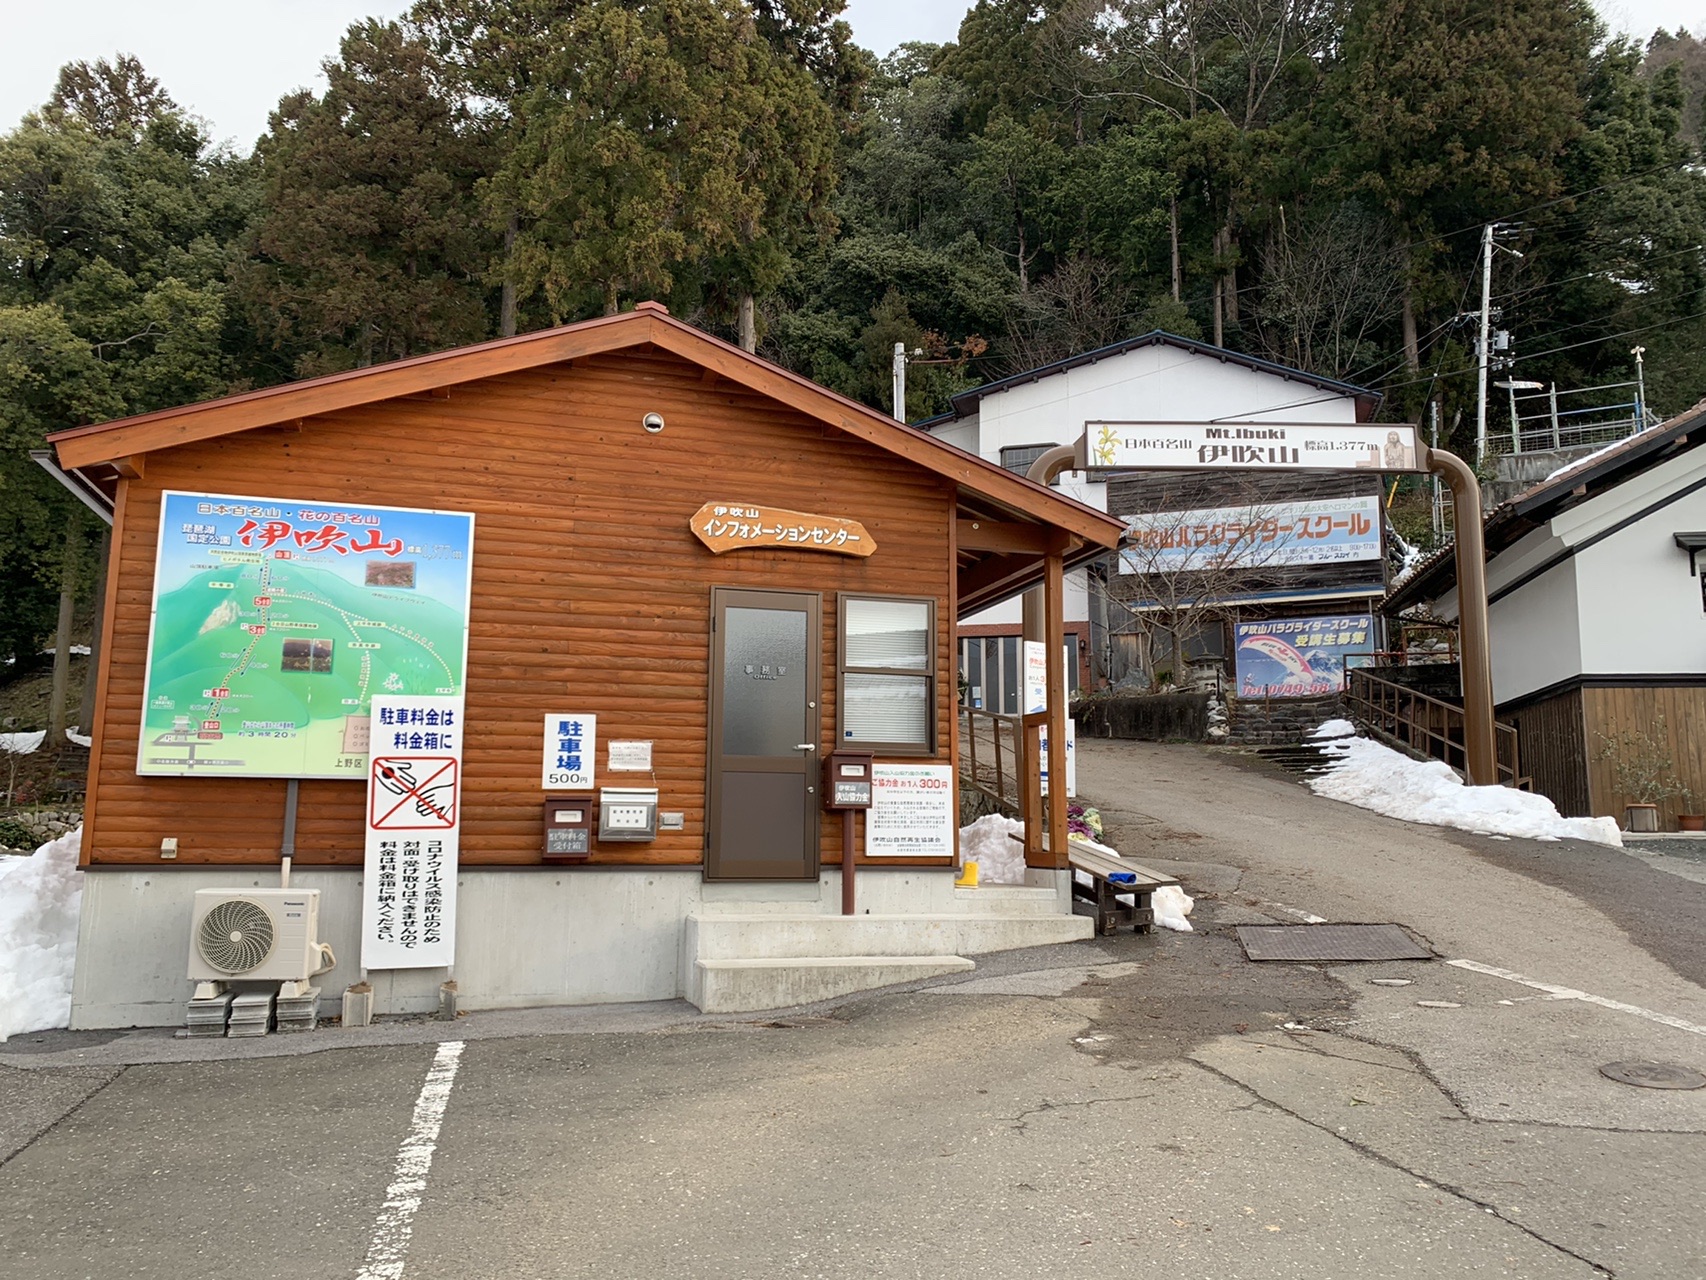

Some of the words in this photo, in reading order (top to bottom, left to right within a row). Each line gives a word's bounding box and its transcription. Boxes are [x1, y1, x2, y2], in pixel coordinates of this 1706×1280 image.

[1206, 428, 1286, 440] Mt.Ibuki
[1125, 438, 1193, 450] 日本百名山
[1304, 440, 1379, 452] 標高1,377m
[1197, 443, 1300, 464] 伊吹山
[713, 506, 759, 519] 伊吹山
[236, 519, 404, 558] 伊吹山
[702, 518, 861, 546] インフォメーションセンター
[1239, 619, 1369, 636] 伊吹山パラグライダースクール
[1295, 632, 1367, 648] 受講生募集
[744, 665, 787, 676] 事務室
[380, 708, 454, 726] 駐車料金は
[394, 732, 453, 750] 料金箱に
[557, 721, 583, 771] 駐車場
[335, 758, 363, 768] 上野区
[549, 774, 588, 784] 500円
[423, 840, 443, 944] コロナウイルス感染防止のため
